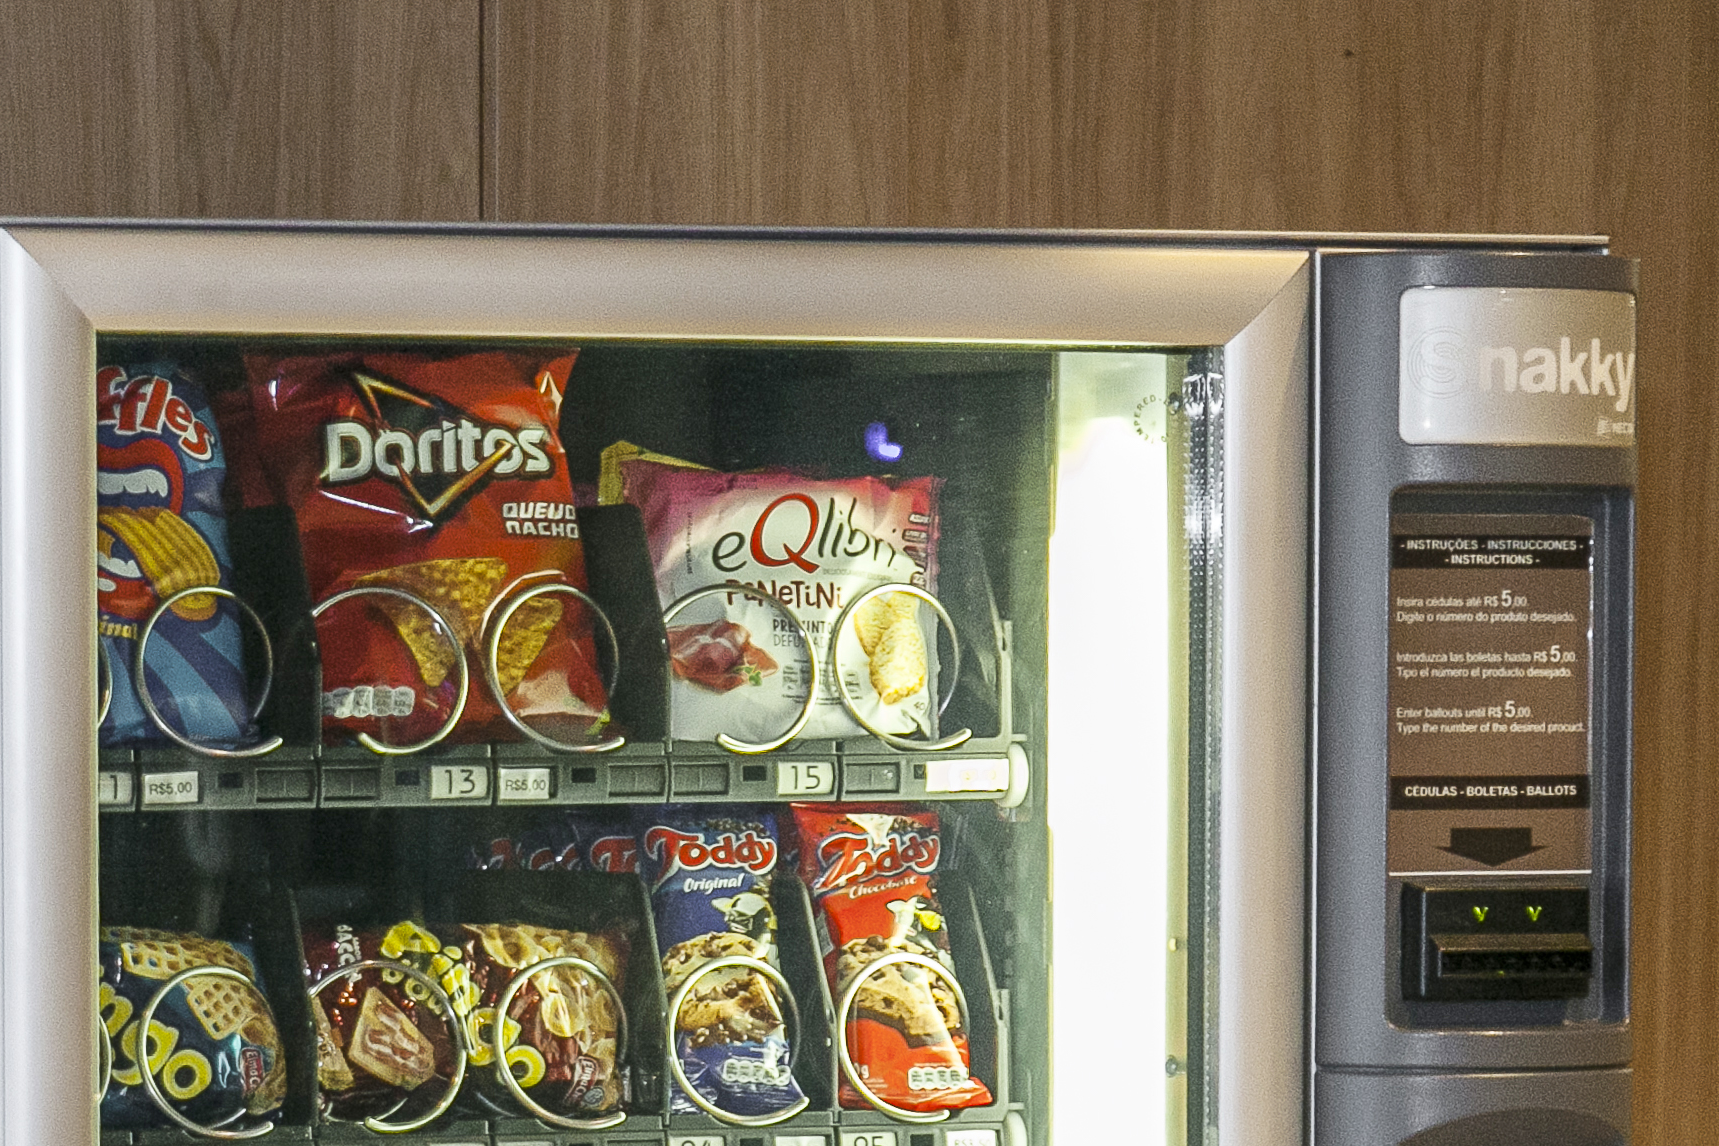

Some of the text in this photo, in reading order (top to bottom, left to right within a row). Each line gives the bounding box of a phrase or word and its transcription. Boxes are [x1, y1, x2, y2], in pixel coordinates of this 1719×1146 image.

[323, 420, 553, 483] Doritos
[504, 521, 580, 539] NACHO
[1406, 538, 1578, 552] INSTRUÇÕES INSTRUCCIONES
[1450, 554, 1534, 566] INSTRUCTIONS
[1426, 612, 1434, 622] o
[1475, 611, 1490, 622] do
[1396, 707, 1422, 718] Enter
[1488, 706, 1502, 718] R$
[1395, 722, 1421, 735] Type
[1422, 722, 1439, 732] the
[1440, 722, 1478, 733] number
[1480, 721, 1490, 732] of
[444, 768, 476, 796] 13
[789, 764, 822, 791] 15
[149, 781, 193, 796] R$5,00
[505, 779, 547, 792] R$5,00
[1404, 784, 1578, 797] CÉDULAS BOLETAS BALLOTS
[645, 827, 777, 888] Toddy
[818, 832, 941, 888] Toddy
[684, 875, 745, 895] Original
